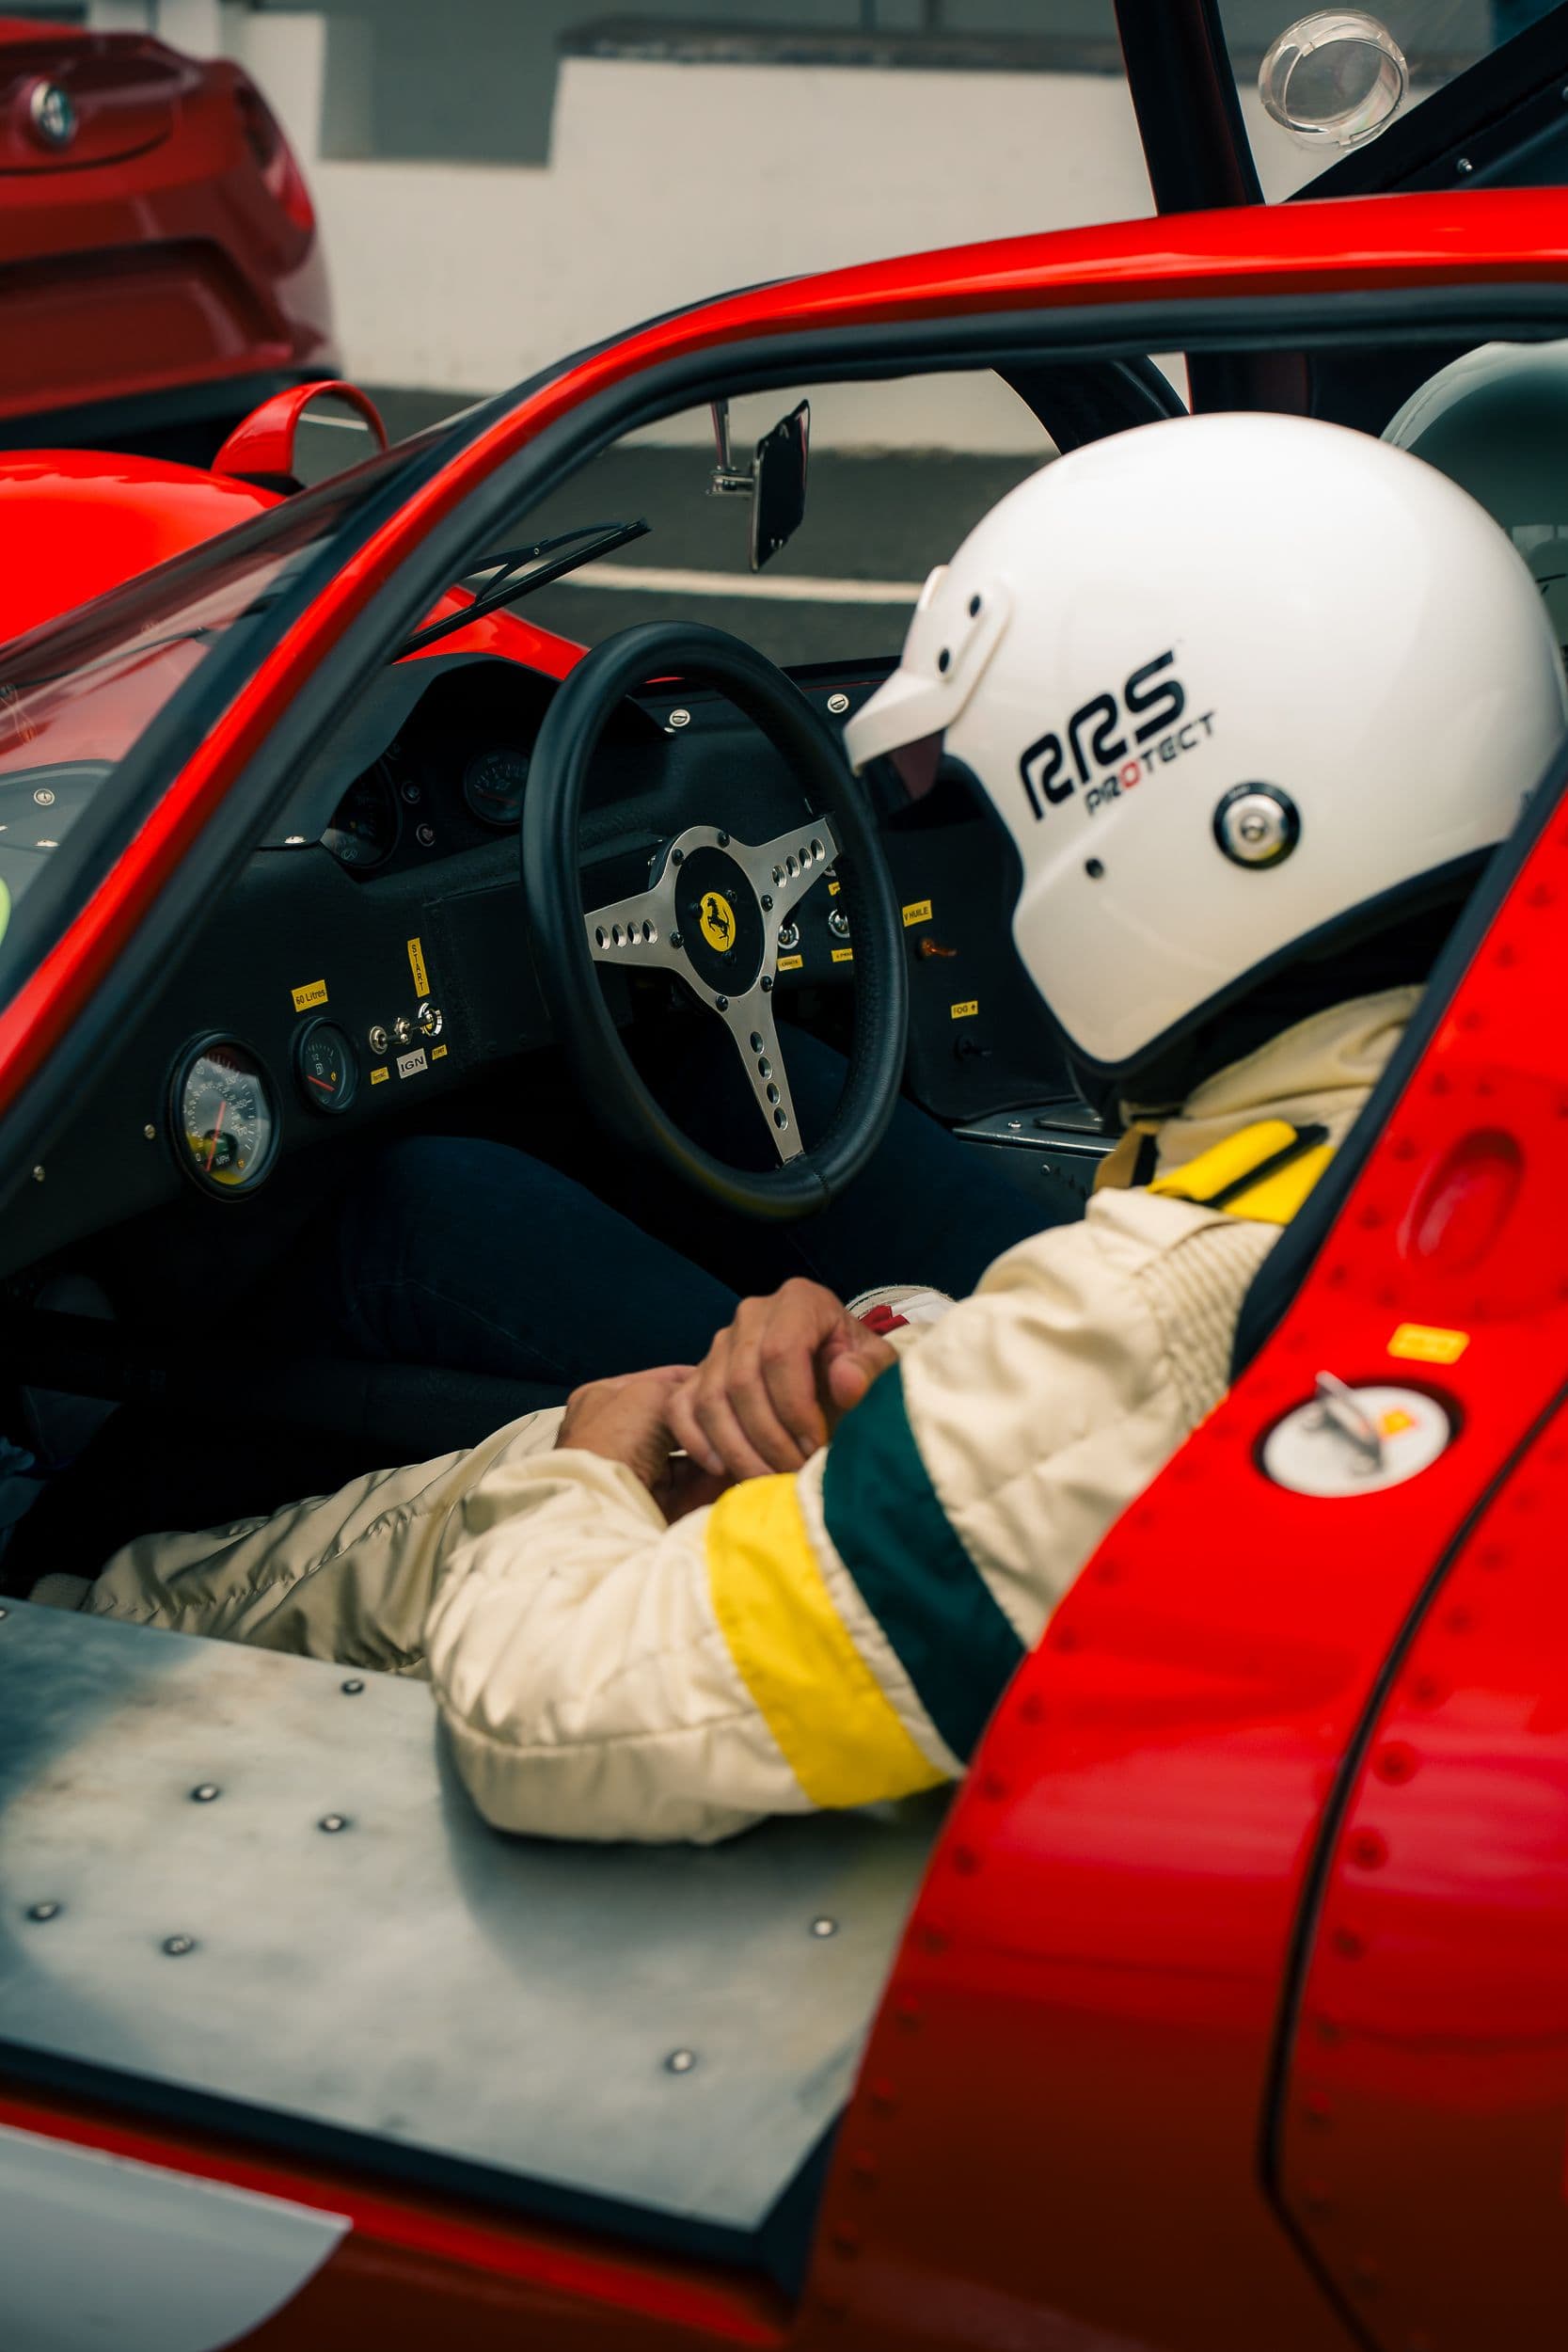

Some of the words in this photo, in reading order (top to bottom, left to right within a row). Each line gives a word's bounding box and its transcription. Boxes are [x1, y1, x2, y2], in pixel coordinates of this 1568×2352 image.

[1019, 649, 1185, 821] RRS
[1085, 709, 1216, 817] PROTECT
[411, 944, 424, 992] START
[305, 989, 325, 1002] Litres
[401, 1056, 424, 1073] IGN
